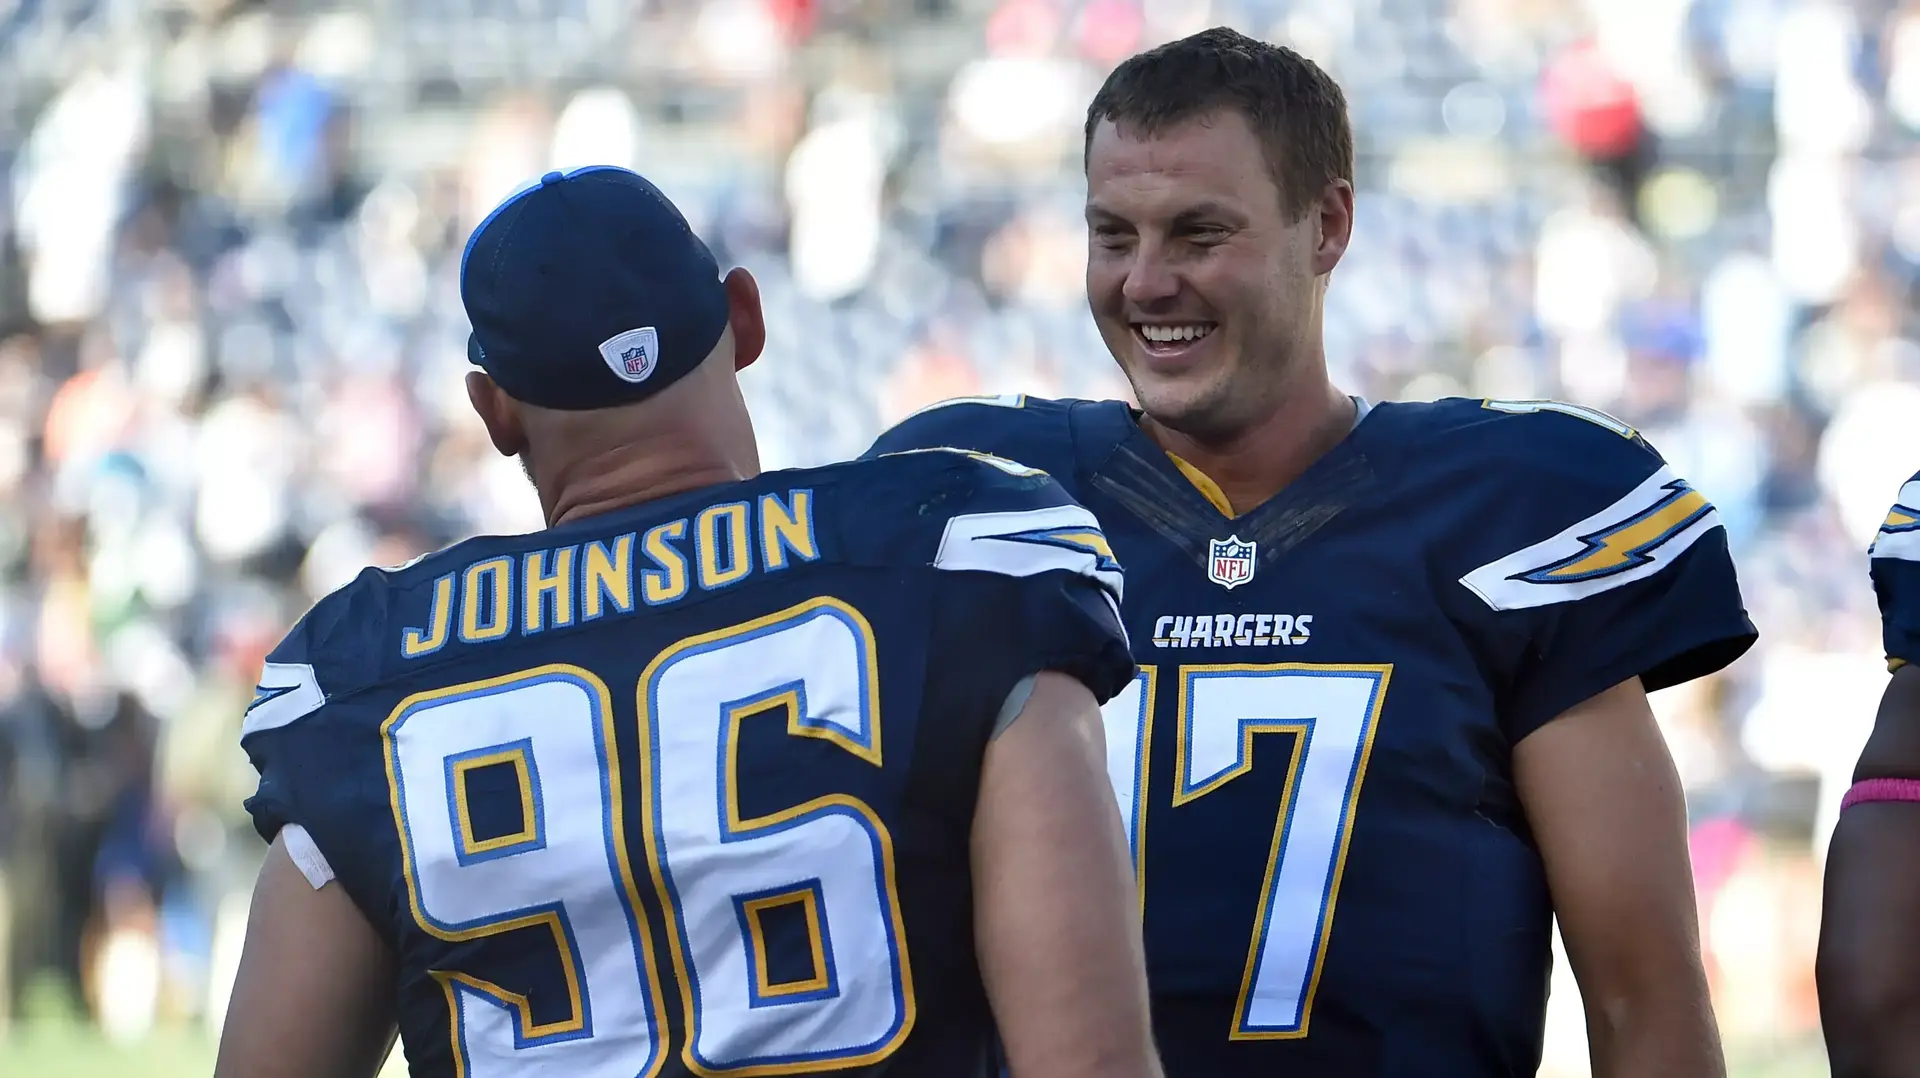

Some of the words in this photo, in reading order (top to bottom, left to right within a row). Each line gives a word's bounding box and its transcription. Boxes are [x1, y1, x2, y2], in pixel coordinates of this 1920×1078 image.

[626, 357, 646, 372] NFL
[402, 489, 820, 658] JOHNSON
[1216, 559, 1247, 580] NFL
[1152, 614, 1313, 648] CHARGERS
[381, 596, 916, 1077] 96
